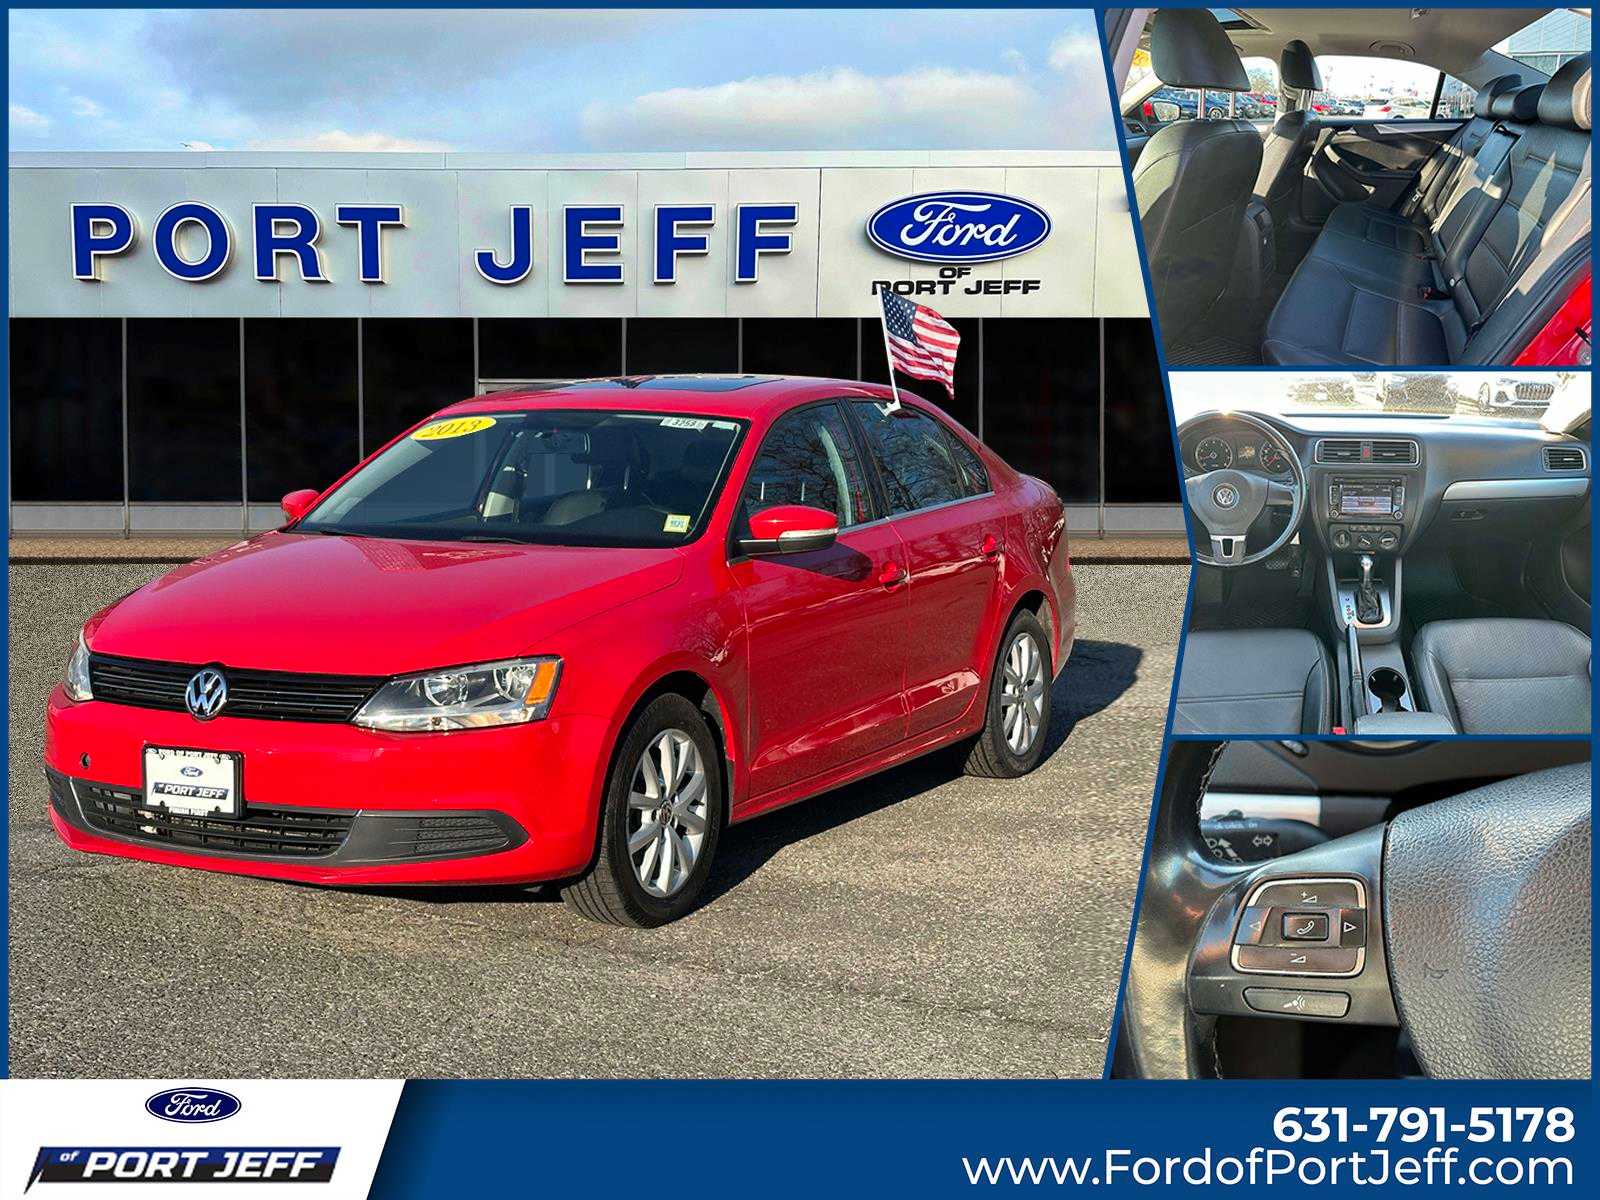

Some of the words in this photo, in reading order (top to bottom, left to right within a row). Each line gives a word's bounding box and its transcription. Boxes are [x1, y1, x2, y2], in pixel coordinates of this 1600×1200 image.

[900, 201, 1022, 247] Ford
[70, 202, 404, 282] PORT
[474, 203, 799, 284] JEFF
[939, 266, 972, 279] OF
[964, 280, 1041, 295] JEFF
[421, 419, 483, 438] 2013
[163, 784, 197, 796] PORT
[195, 788, 226, 799] JEFF
